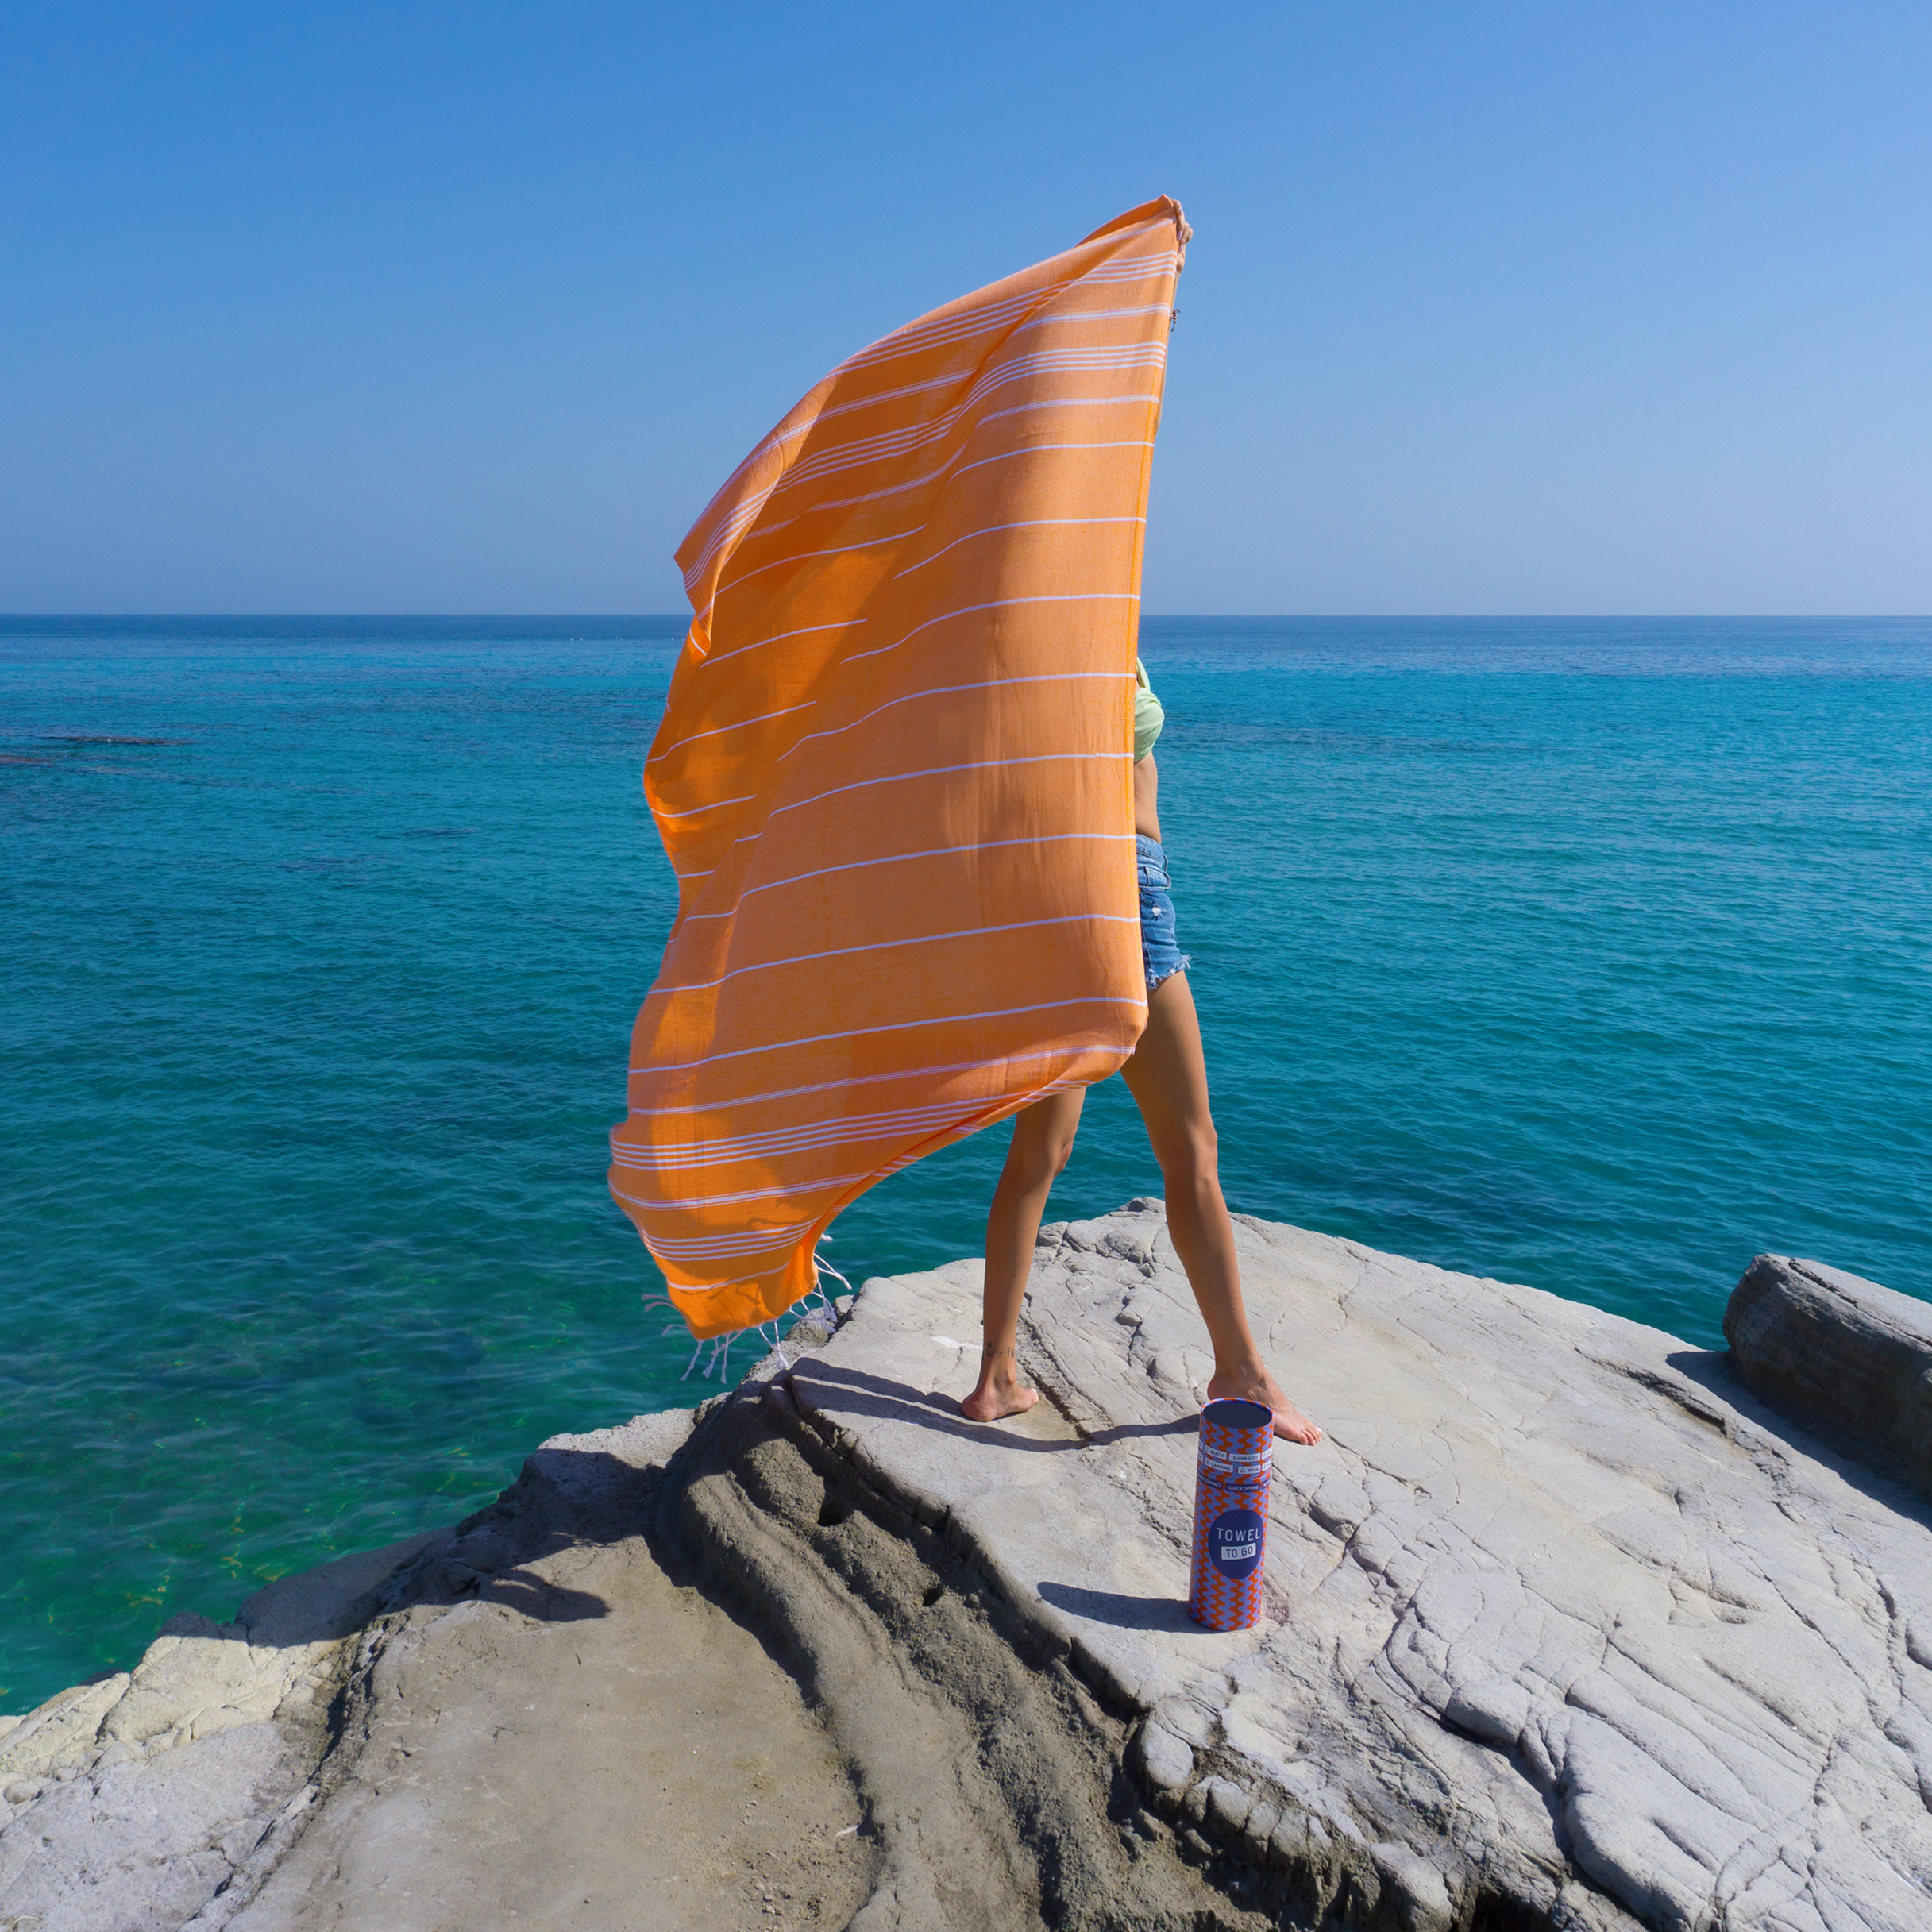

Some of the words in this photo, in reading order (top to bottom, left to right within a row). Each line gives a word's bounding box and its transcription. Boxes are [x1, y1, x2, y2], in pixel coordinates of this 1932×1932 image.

[1211, 1462, 1231, 1471] CAMPING
[1217, 1527, 1260, 1541] TOWEL
[1225, 1548, 1238, 1558] TO
[1241, 1546, 1253, 1556] GO
